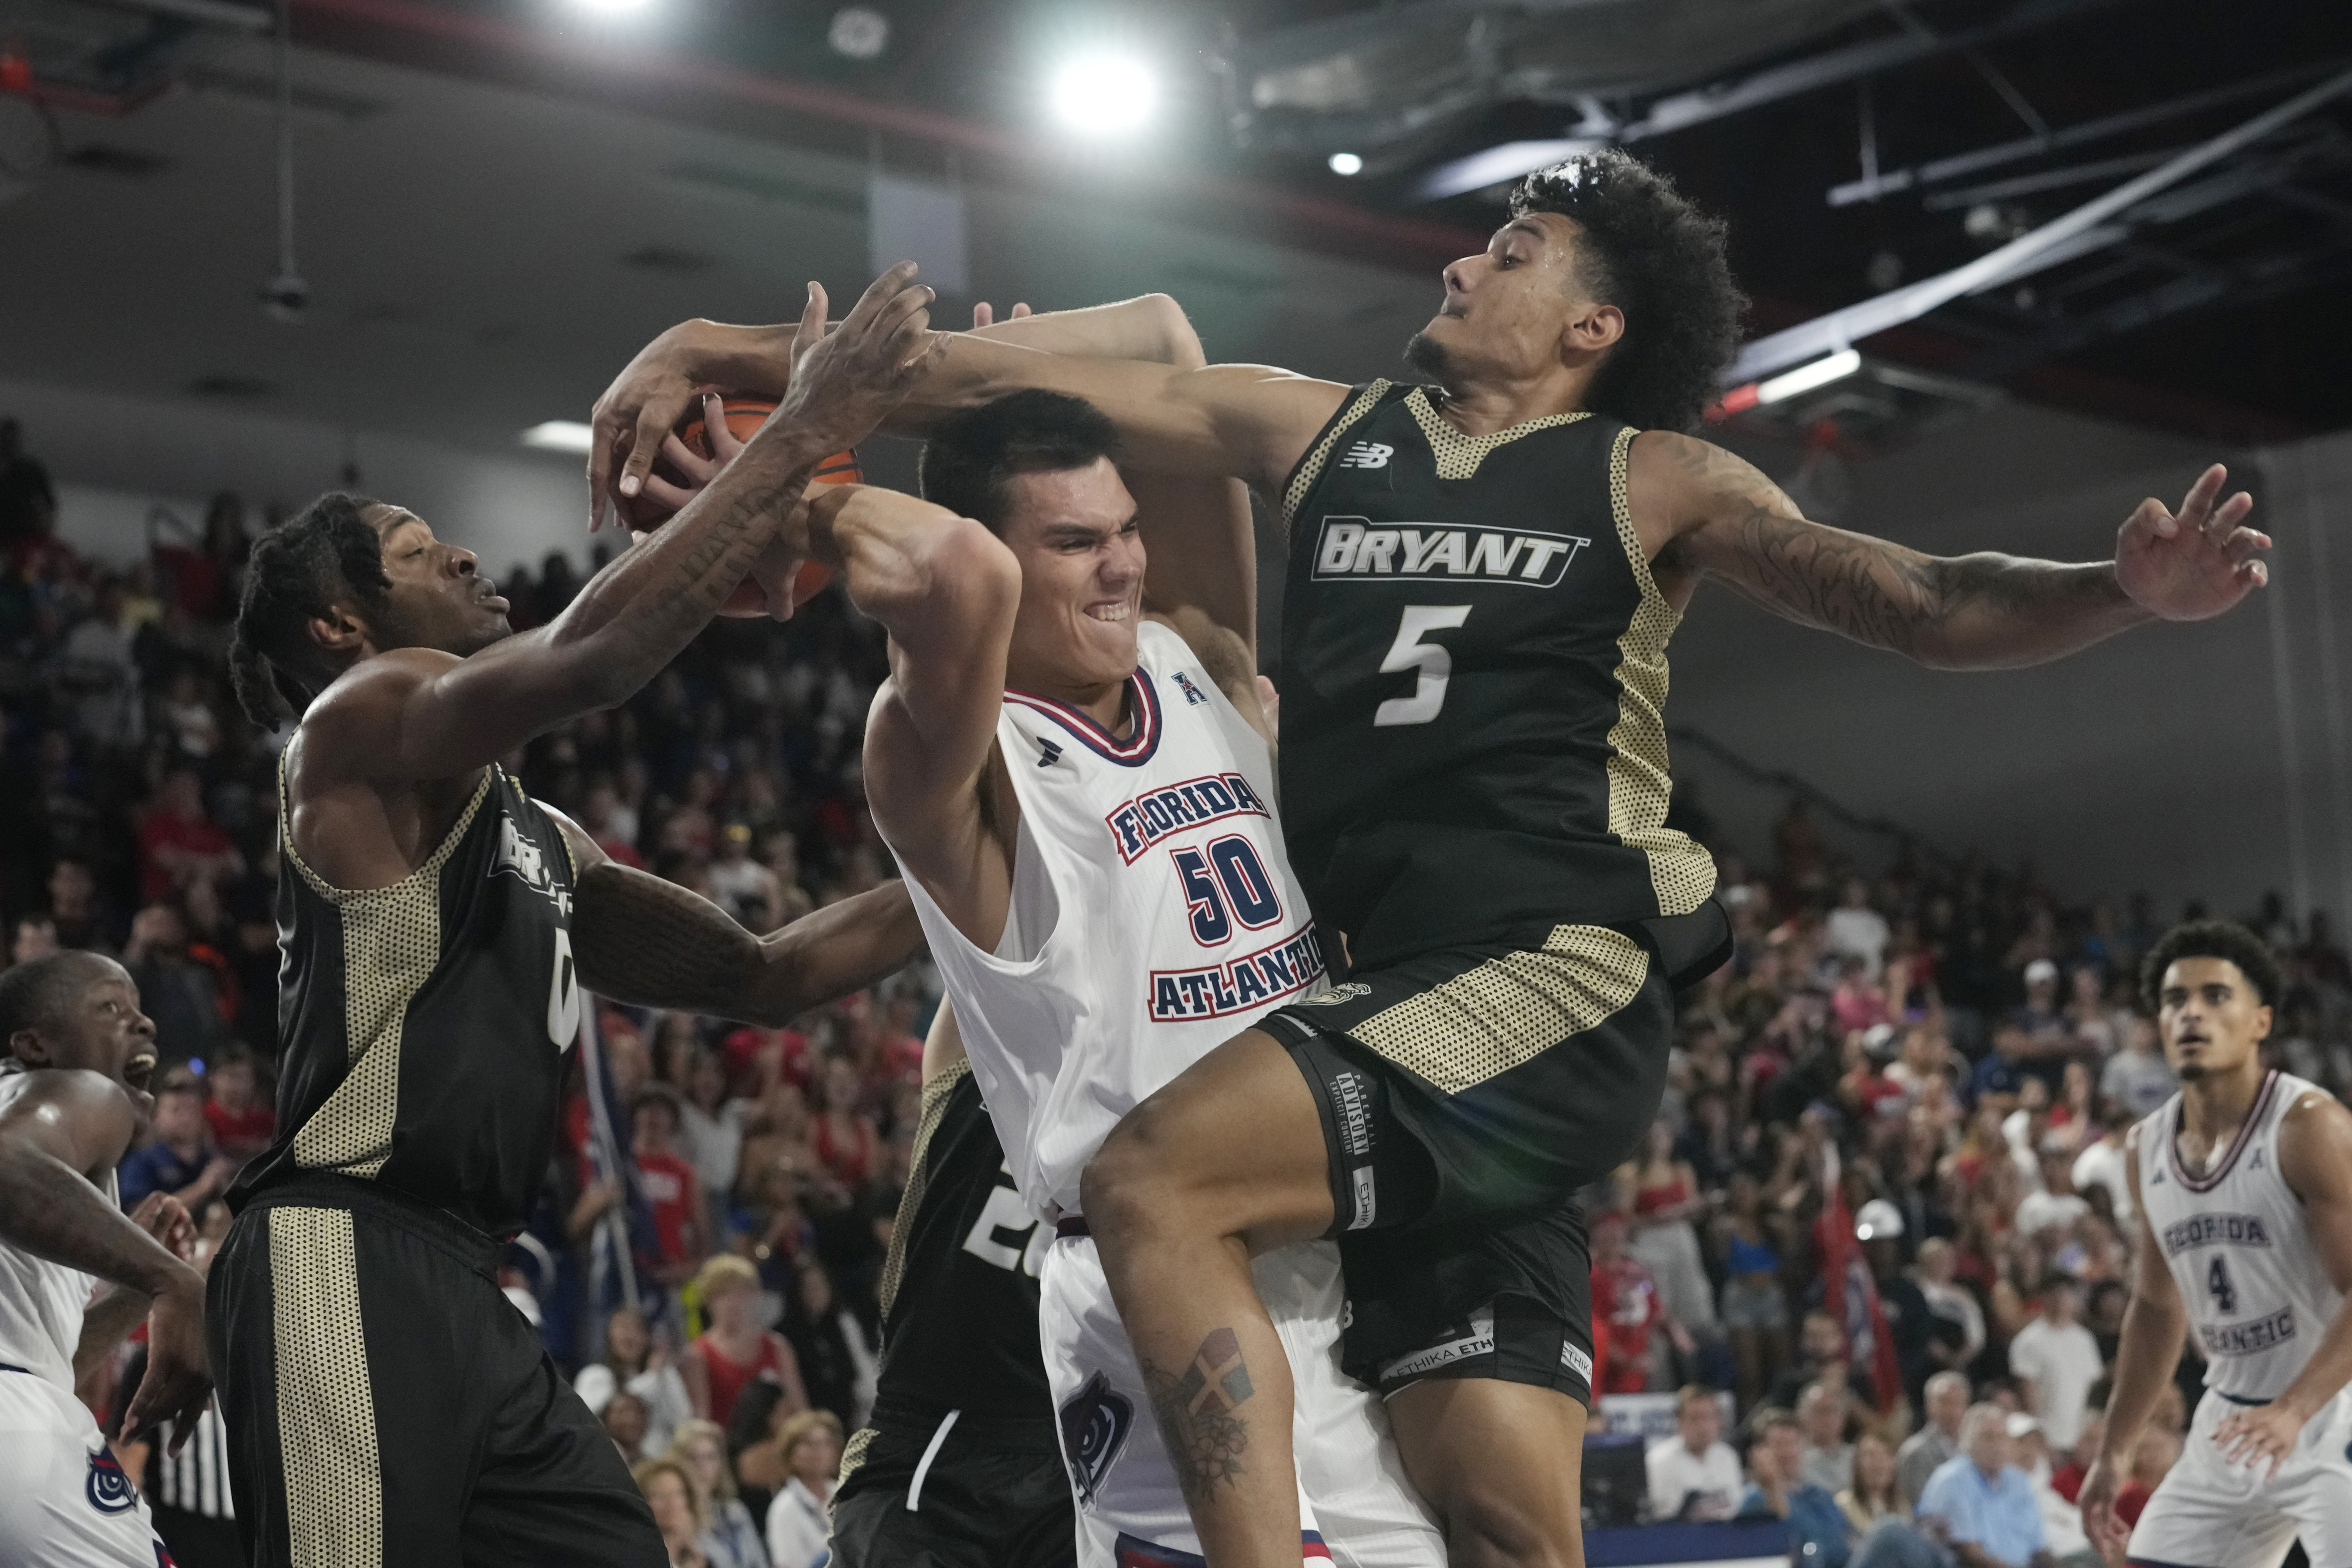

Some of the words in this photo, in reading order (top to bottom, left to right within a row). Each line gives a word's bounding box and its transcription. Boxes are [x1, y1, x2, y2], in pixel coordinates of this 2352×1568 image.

[1317, 523, 1570, 579] BRYANT
[1374, 605, 1473, 726] 5
[1110, 775, 1267, 860] FLORIDA
[1172, 836, 1281, 944] 50
[1329, 1081, 1345, 1117] EXPLICIT
[1340, 1120, 1353, 1154] CONTENT
[1338, 1075, 1369, 1151] ADVISORY
[1354, 1074, 1376, 1147] PARENTAL
[962, 1156, 1047, 1279] 2
[2209, 1255, 2235, 1313] 4
[1397, 1350, 1456, 1376] ETHIKA
